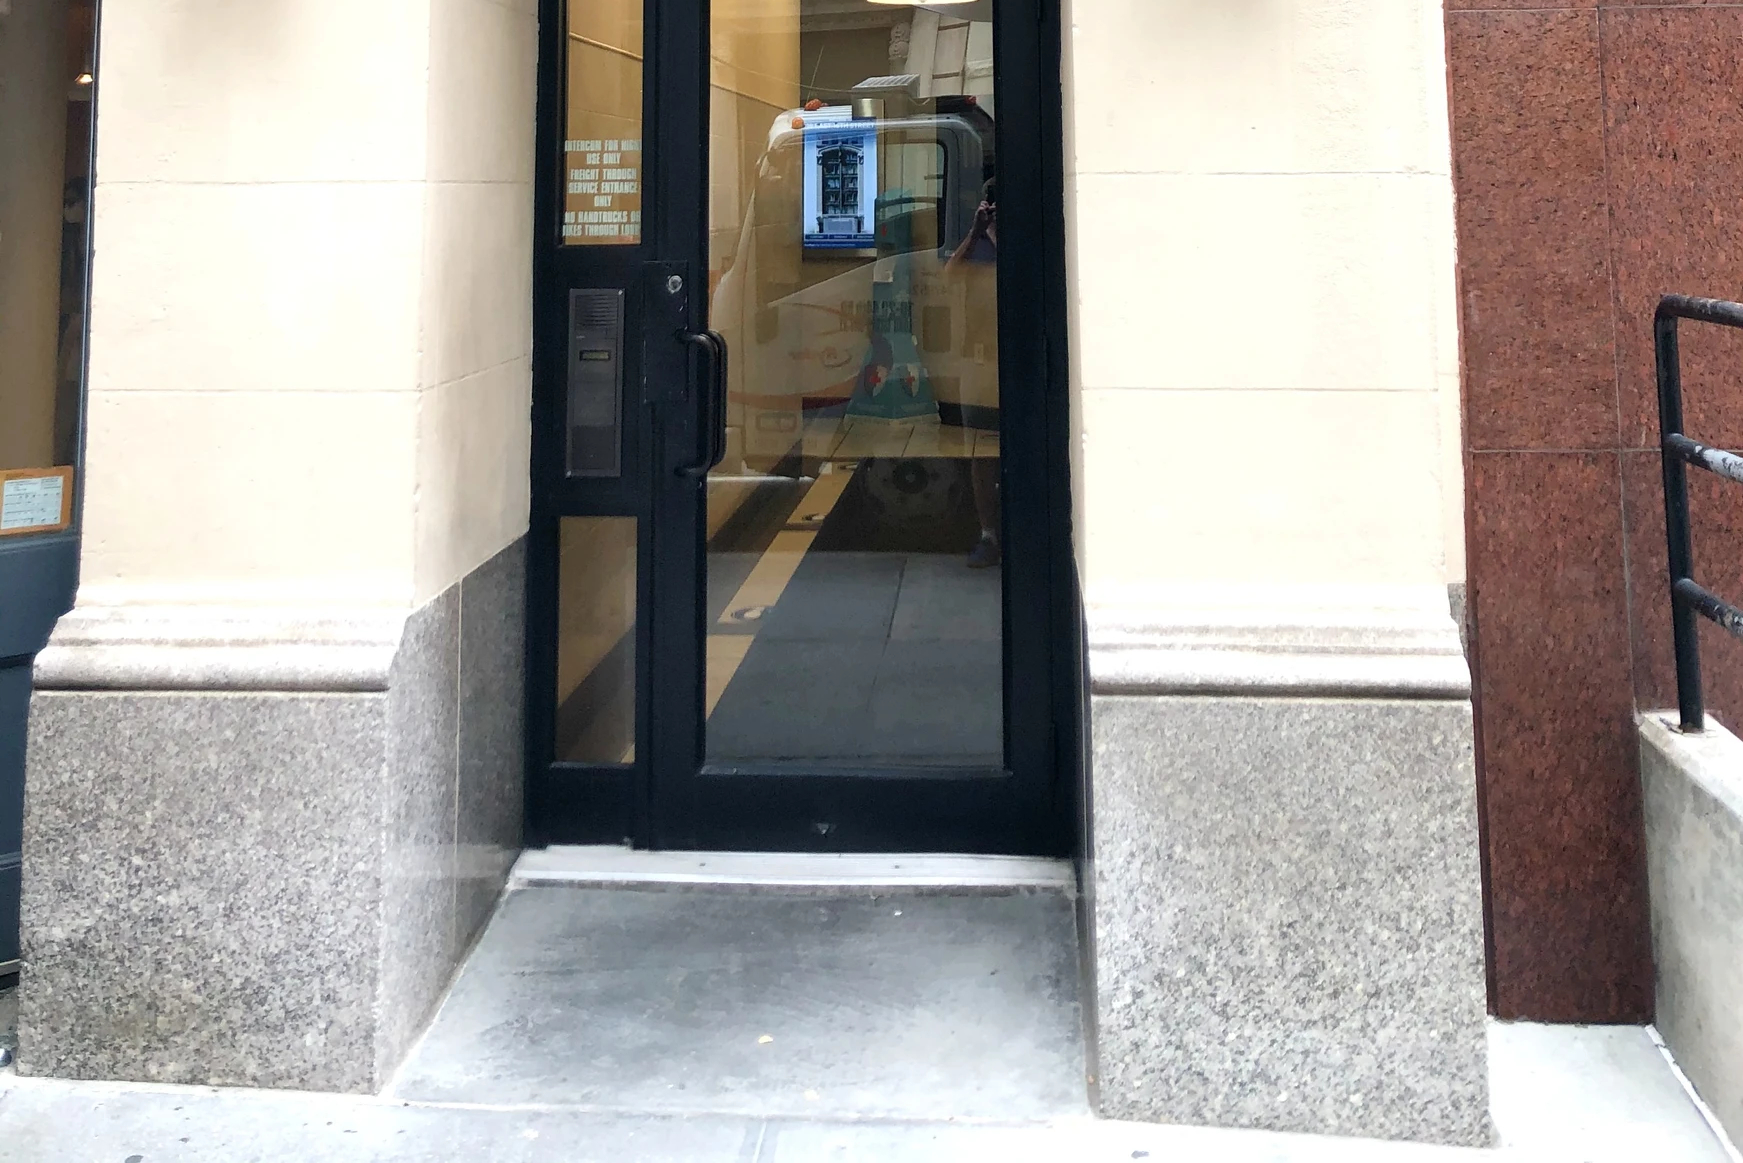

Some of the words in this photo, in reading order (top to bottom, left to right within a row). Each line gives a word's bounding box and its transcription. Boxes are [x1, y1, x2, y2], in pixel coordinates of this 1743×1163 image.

[605, 140, 618, 151] FOR
[586, 153, 600, 164] USE
[603, 152, 621, 164] ONLY
[570, 169, 599, 180] FREIGHT
[603, 168, 636, 180] THROUGH
[568, 182, 598, 193] SERVICE
[601, 182, 638, 194] ENTRANCE
[594, 195, 612, 207] ONLY
[565, 211, 575, 222] NO
[578, 211, 628, 222] HANDTRUCKS
[585, 224, 618, 236] THROUGH
